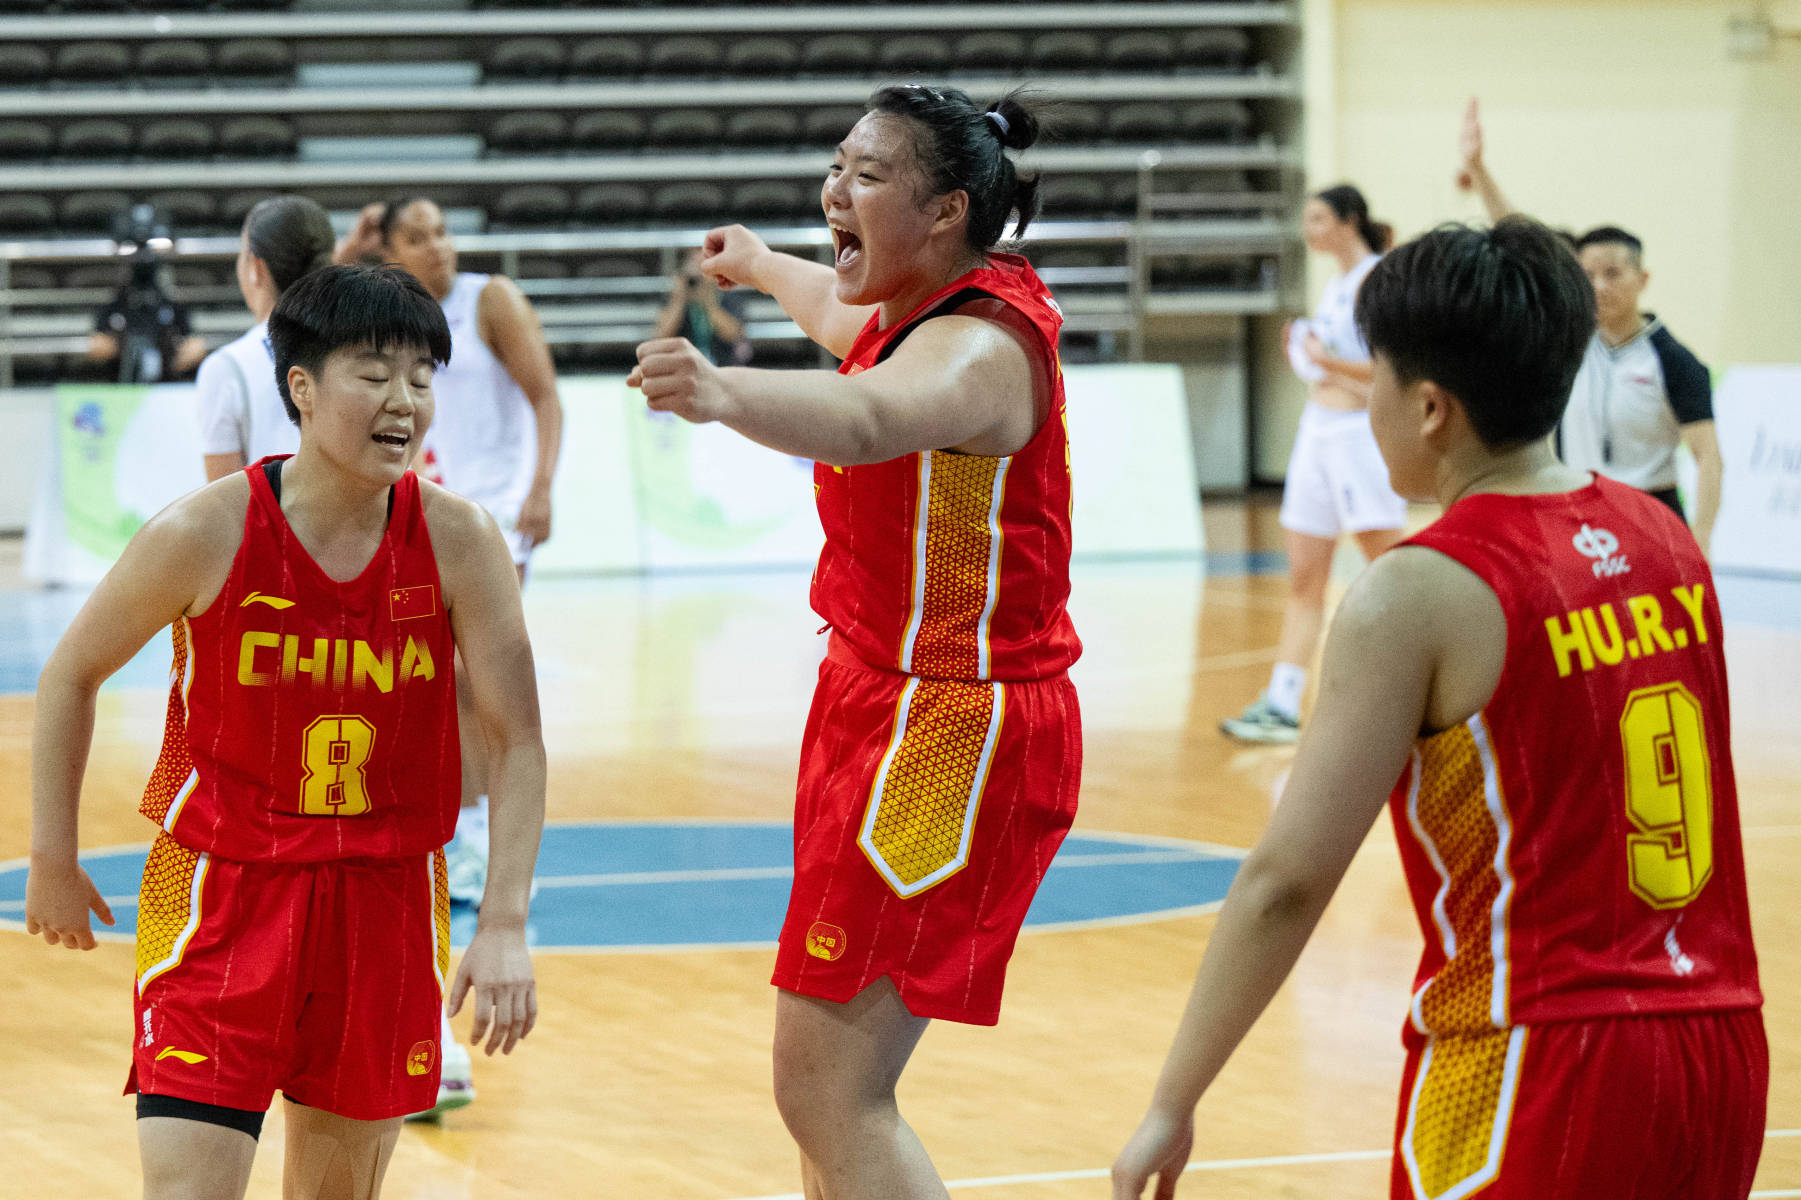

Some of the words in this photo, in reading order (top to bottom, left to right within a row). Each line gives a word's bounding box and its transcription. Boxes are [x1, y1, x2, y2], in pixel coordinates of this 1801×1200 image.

[238, 631, 436, 694] CHINA
[1544, 584, 1708, 678] HU.R.Y
[298, 714, 377, 816] 8
[1619, 681, 1713, 911] 9
